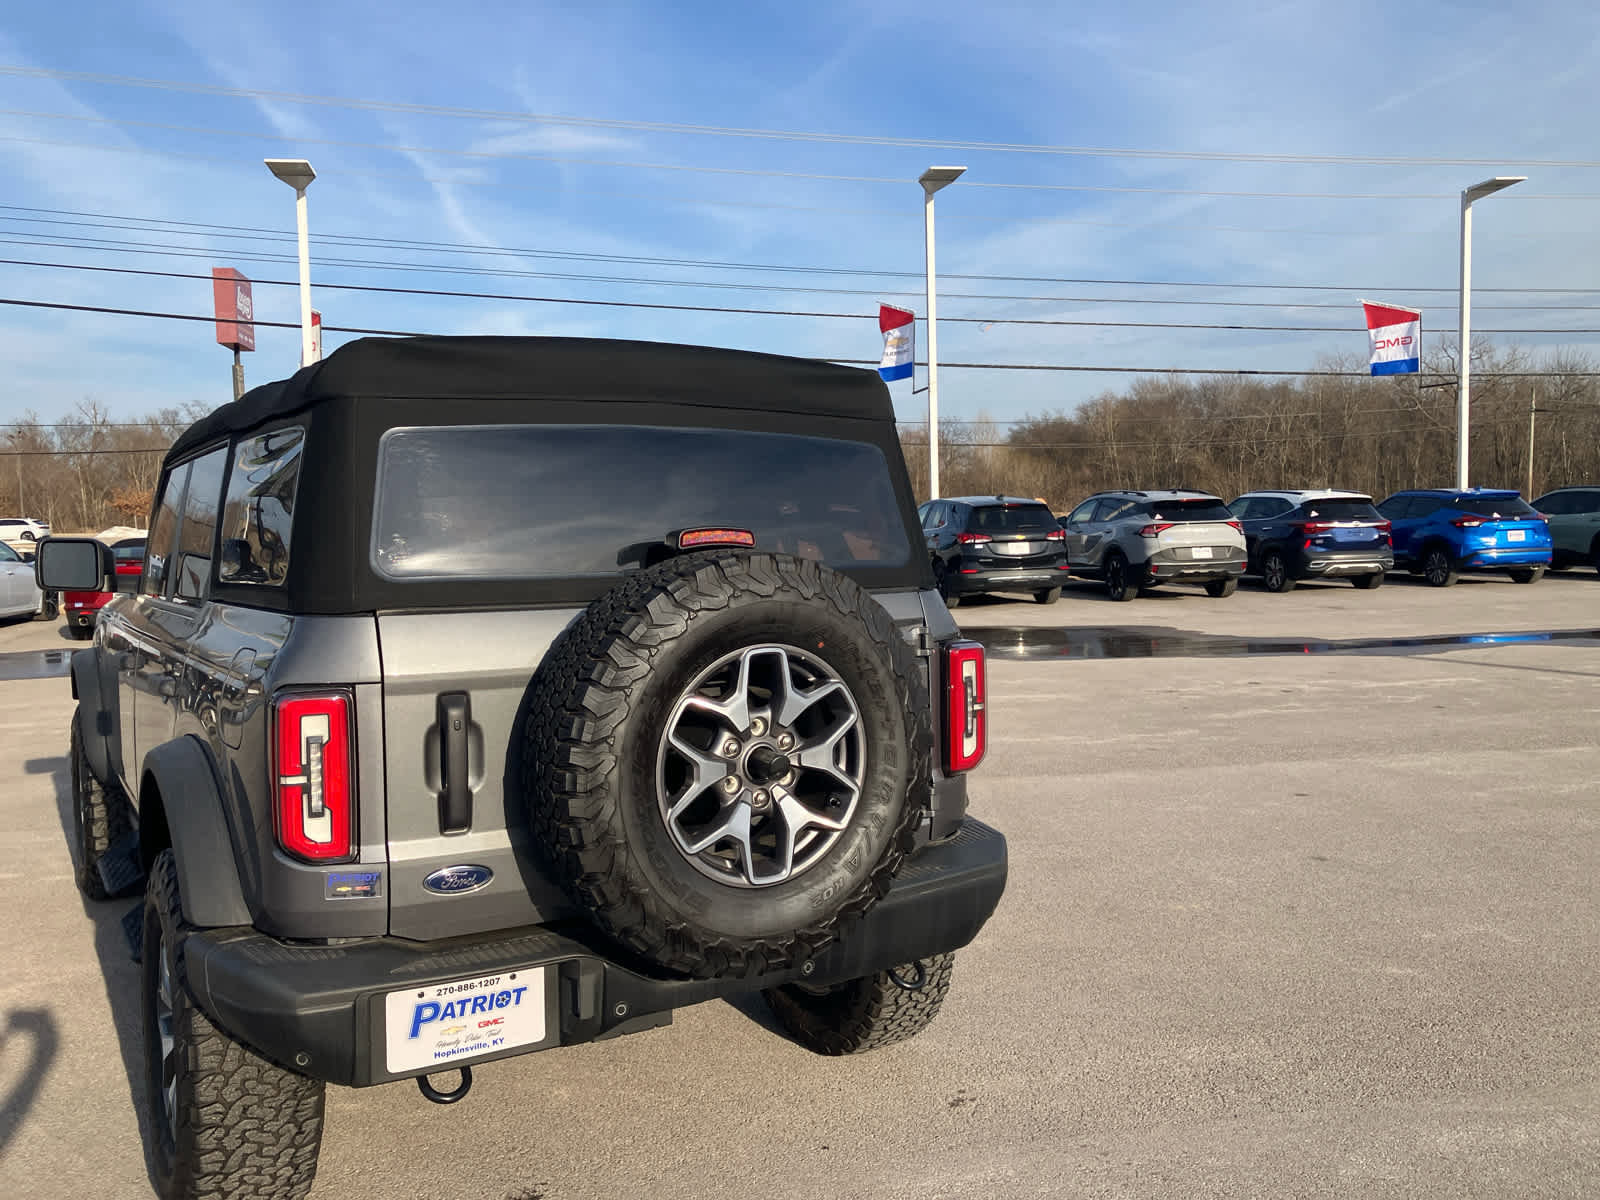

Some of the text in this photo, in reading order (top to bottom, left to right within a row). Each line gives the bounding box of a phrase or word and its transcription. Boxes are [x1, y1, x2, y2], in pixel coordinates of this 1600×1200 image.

[440, 871, 478, 889] Ford
[436, 977, 501, 997] 270-886-1207
[408, 986, 527, 1040] PATRIOT
[478, 1017, 504, 1028] GMC
[434, 1041, 490, 1059] Hopkinsville,
[492, 1037, 505, 1046] KY
